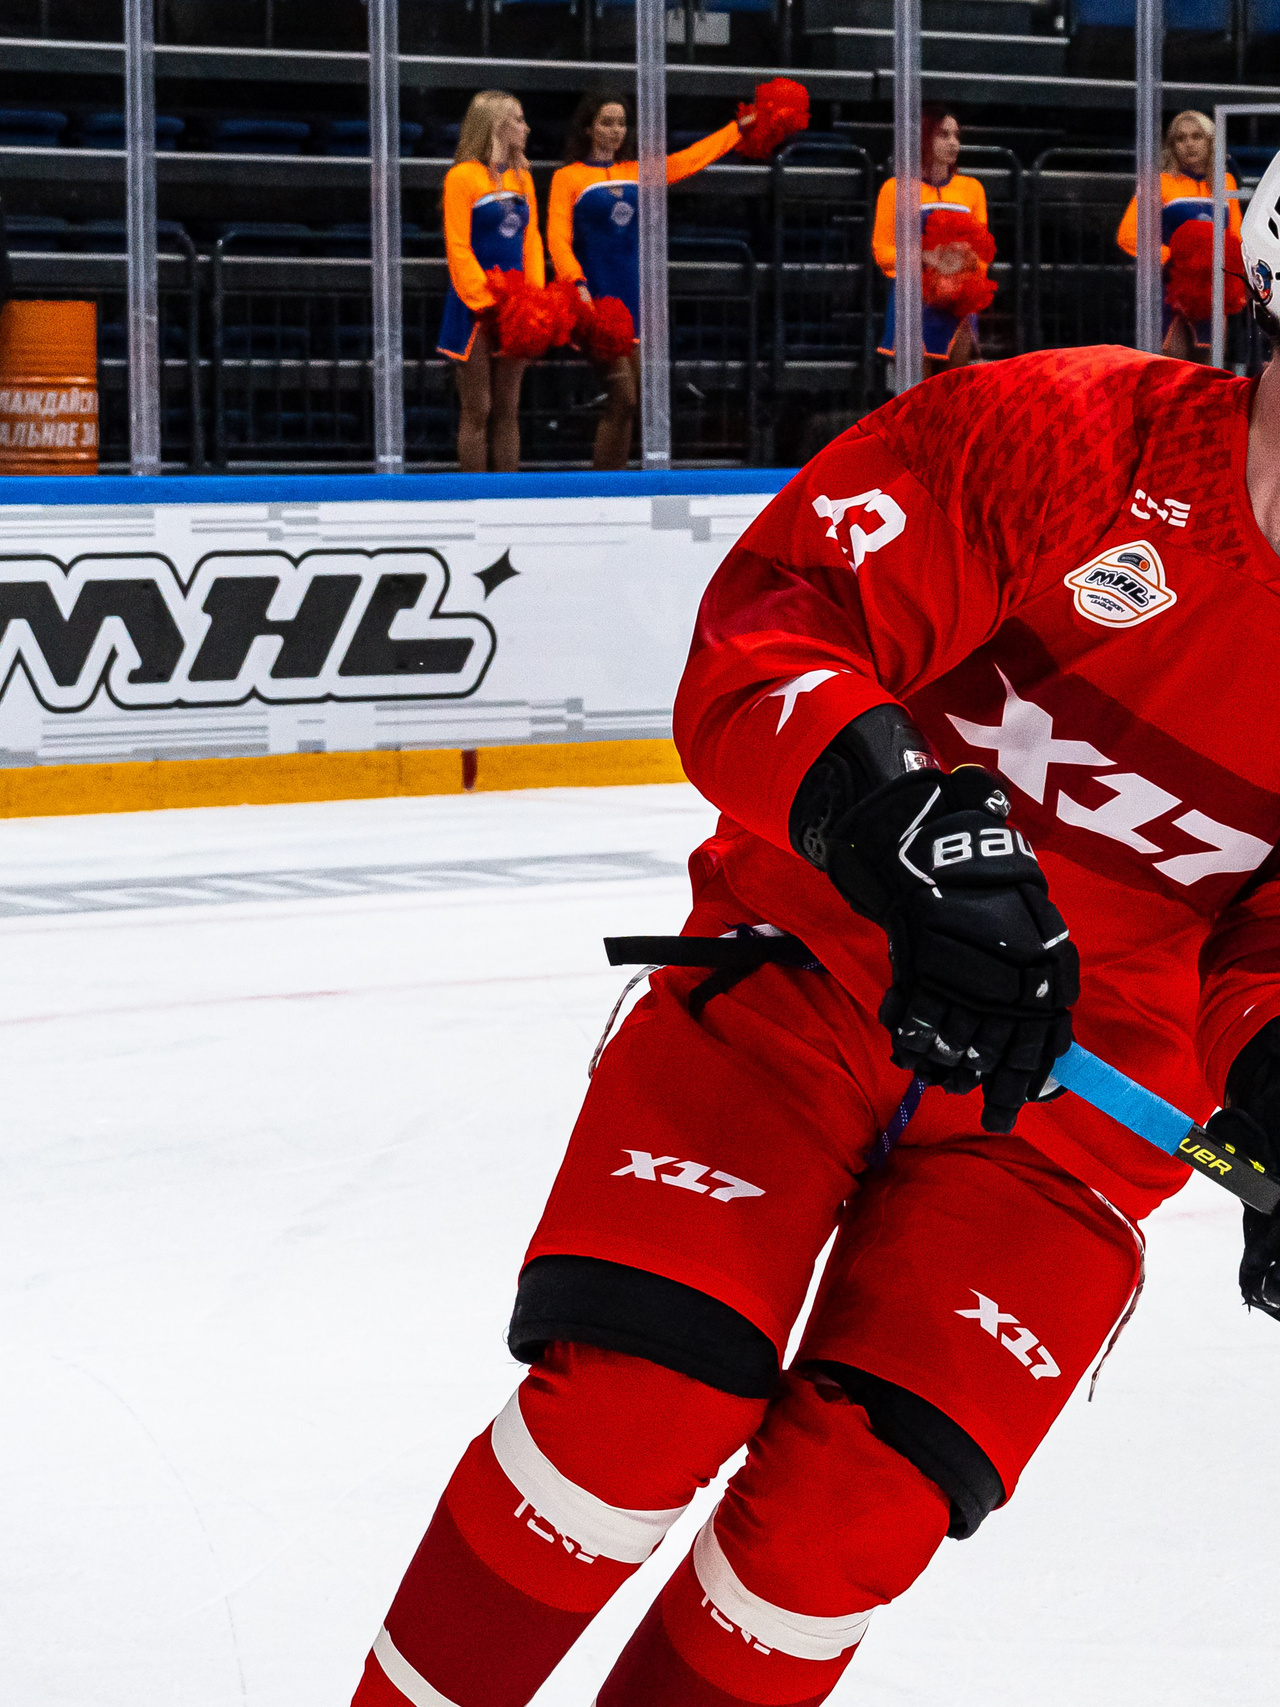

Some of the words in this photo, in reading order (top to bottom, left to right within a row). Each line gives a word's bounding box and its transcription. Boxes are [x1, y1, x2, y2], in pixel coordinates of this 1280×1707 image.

[1086, 570, 1149, 606] MHL
[1101, 597, 1125, 613] HOCKEY
[944, 662, 1274, 886] X17
[610, 1149, 766, 1202] X17
[953, 1287, 1061, 1380] X17
